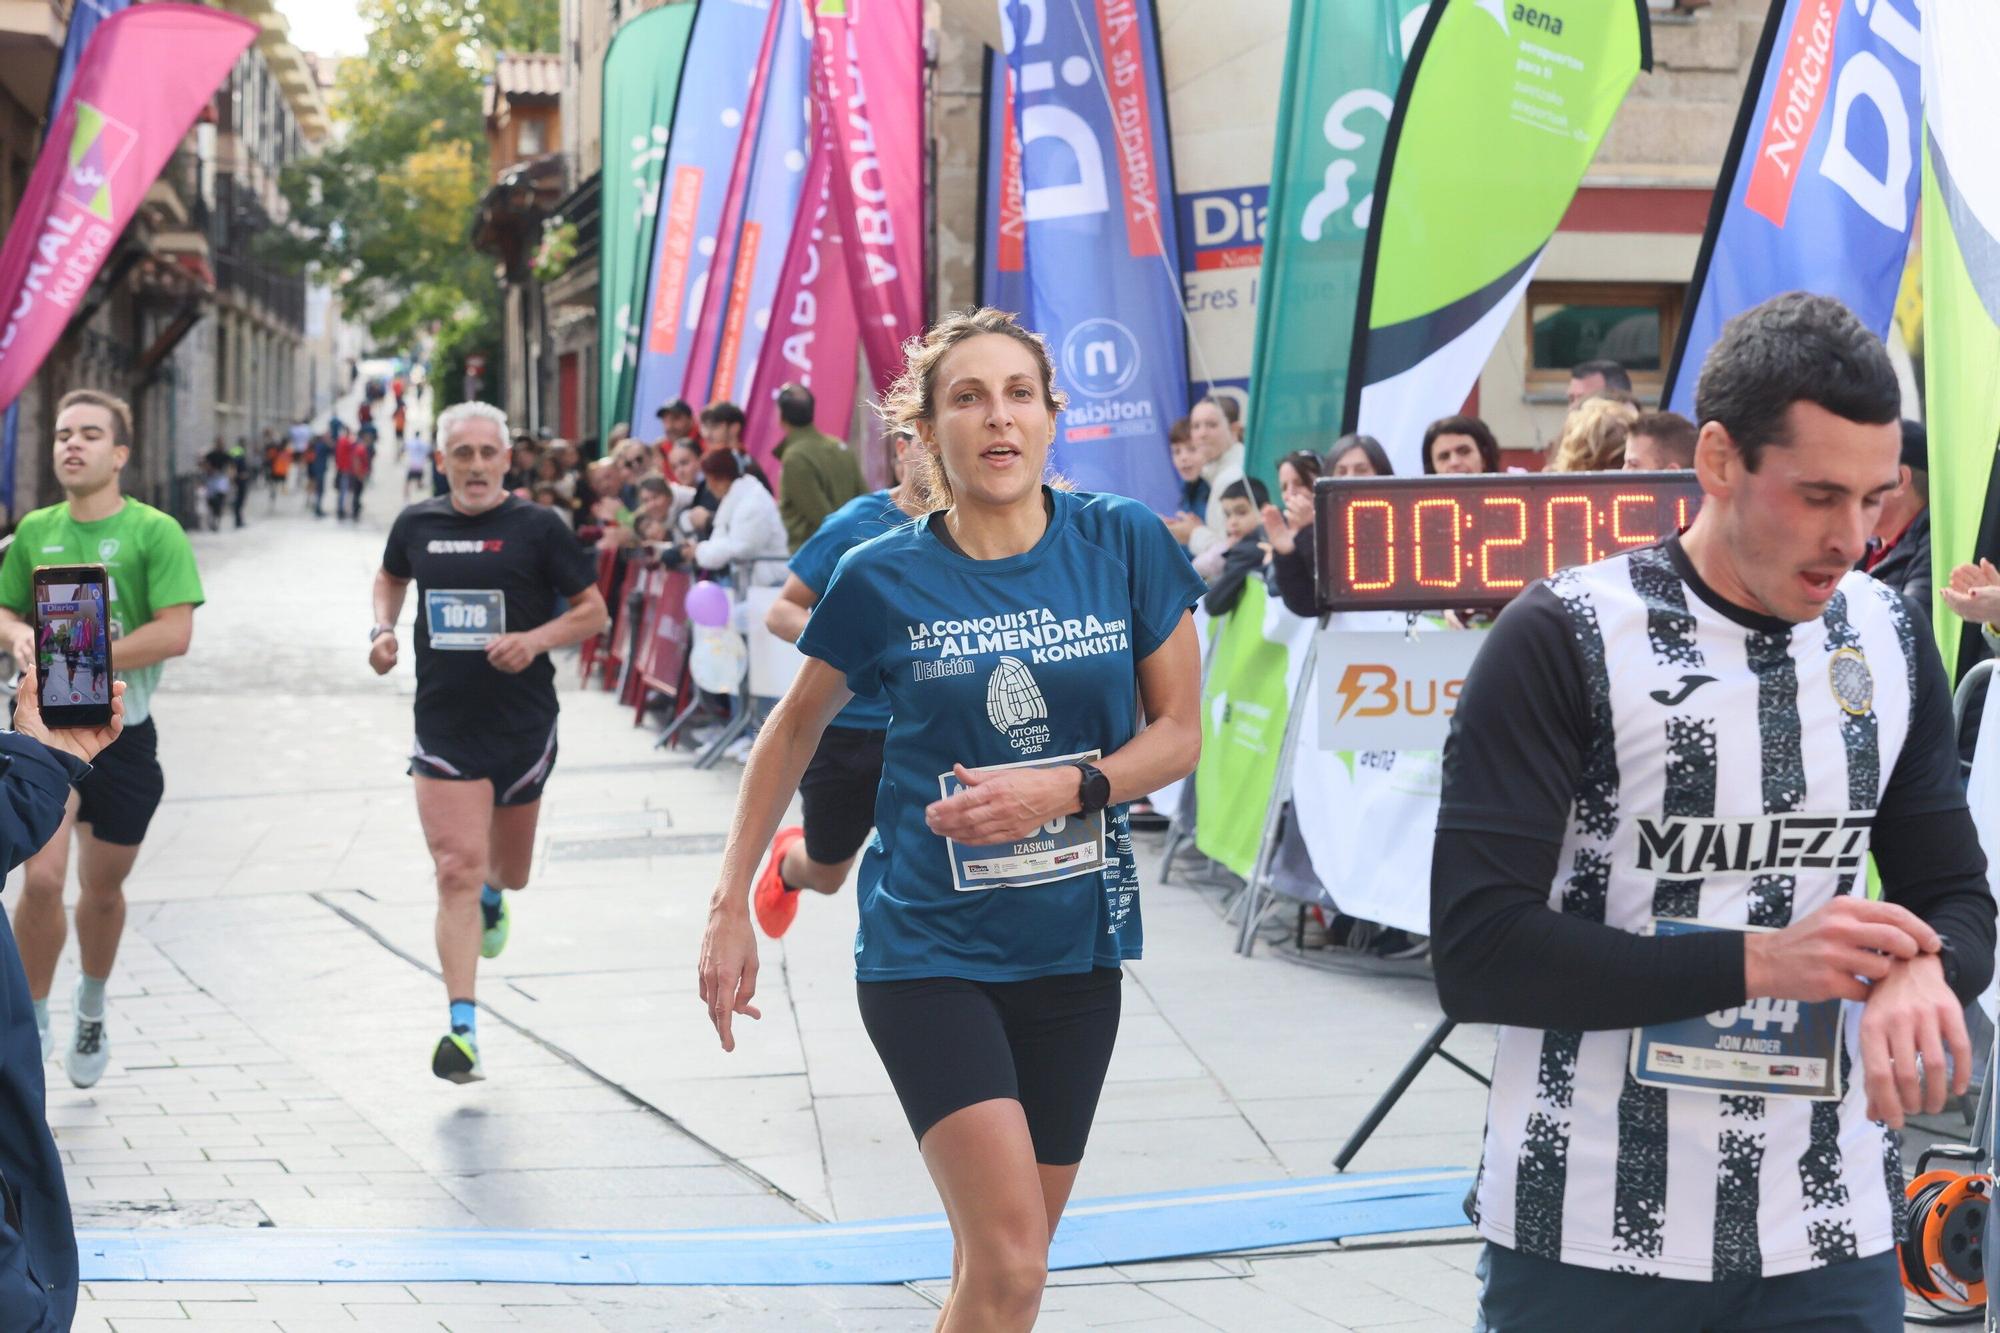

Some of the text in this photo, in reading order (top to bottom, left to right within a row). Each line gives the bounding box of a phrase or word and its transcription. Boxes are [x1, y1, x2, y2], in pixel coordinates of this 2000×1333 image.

[1513, 3, 1563, 36] aena
[1765, 2, 1833, 179] Noticias
[45, 223, 113, 308] kutxa
[441, 604, 487, 628] 1078
[907, 607, 1057, 642] LA CONQUISTA
[911, 641, 926, 651] DE
[926, 637, 942, 648] LA
[1032, 632, 1129, 665] KONKISTA
[924, 656, 976, 678] Edición
[1008, 725, 1050, 739] VITORIA
[1010, 733, 1051, 749] GASTEIZ
[1021, 744, 1043, 755] 2025
[1013, 839, 1056, 855] IZASKUN
[1714, 1034, 1782, 1054] JON ANDER
